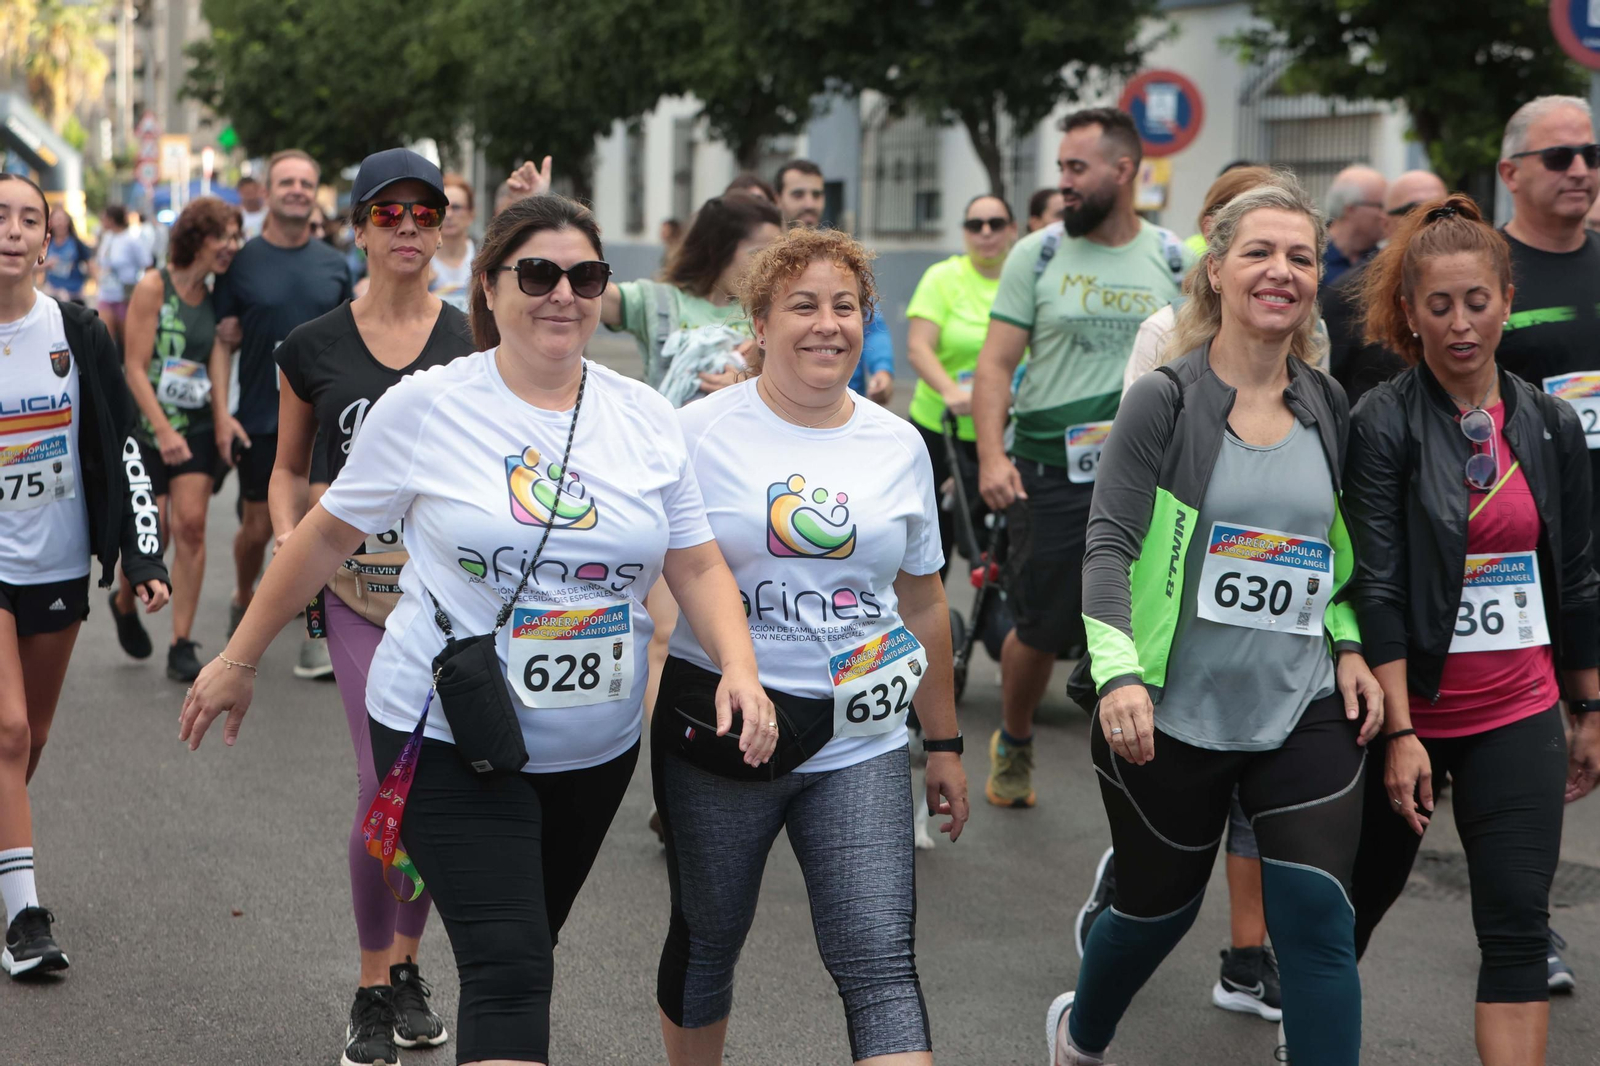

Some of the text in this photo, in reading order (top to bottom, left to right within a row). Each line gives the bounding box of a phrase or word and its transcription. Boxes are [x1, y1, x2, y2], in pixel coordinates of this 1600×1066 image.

[1079, 452, 1101, 472] 6
[0, 471, 45, 500] 75
[123, 436, 159, 554] adidas
[1221, 533, 1323, 559] CARRERA POPULAR
[1274, 555, 1301, 565] SANTO
[1302, 559, 1327, 570] ANGEL
[1477, 562, 1526, 574] POPULAR
[1475, 575, 1503, 584] SANTO
[1505, 573, 1532, 582] ANGEL
[569, 590, 613, 603] ESPECIALES
[1214, 571, 1293, 616] 630
[523, 611, 624, 628] CARRERA POPULAR
[580, 626, 607, 636] SANTO
[607, 623, 628, 633] ANGEL
[1454, 599, 1505, 637] 36
[770, 633, 827, 643] NECESIDADES
[827, 629, 865, 642] ESPECIALES
[790, 626, 826, 635] FAMILIAS
[828, 625, 839, 633] DE
[837, 633, 908, 671] CARRERA POPULAR
[882, 651, 899, 664] SANTO
[898, 641, 917, 655] ANGEL
[523, 652, 602, 692] 628
[846, 675, 909, 724] 632
[383, 817, 399, 856] afines
